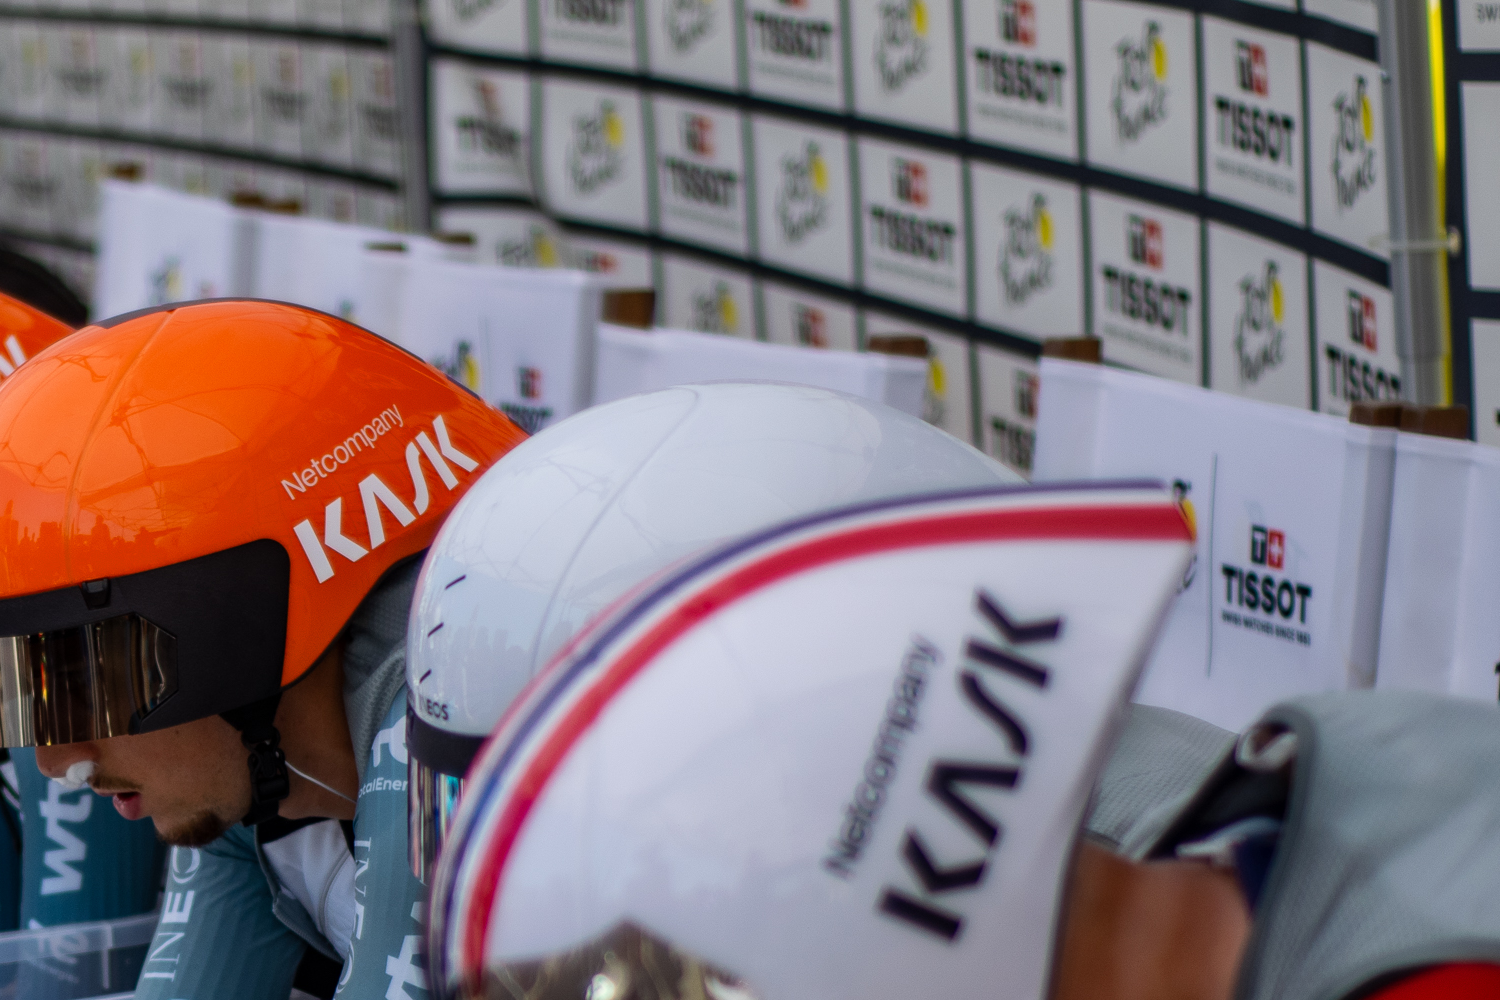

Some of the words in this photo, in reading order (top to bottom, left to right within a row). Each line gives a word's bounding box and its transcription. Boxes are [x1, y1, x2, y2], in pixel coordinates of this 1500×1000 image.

[1214, 97, 1295, 166] TISSOT
[1102, 265, 1191, 337] TISSOT
[281, 403, 404, 501] Netcompany
[293, 414, 480, 584] KASK
[1222, 563, 1312, 625] TISSOT
[876, 588, 1063, 942] KASK
